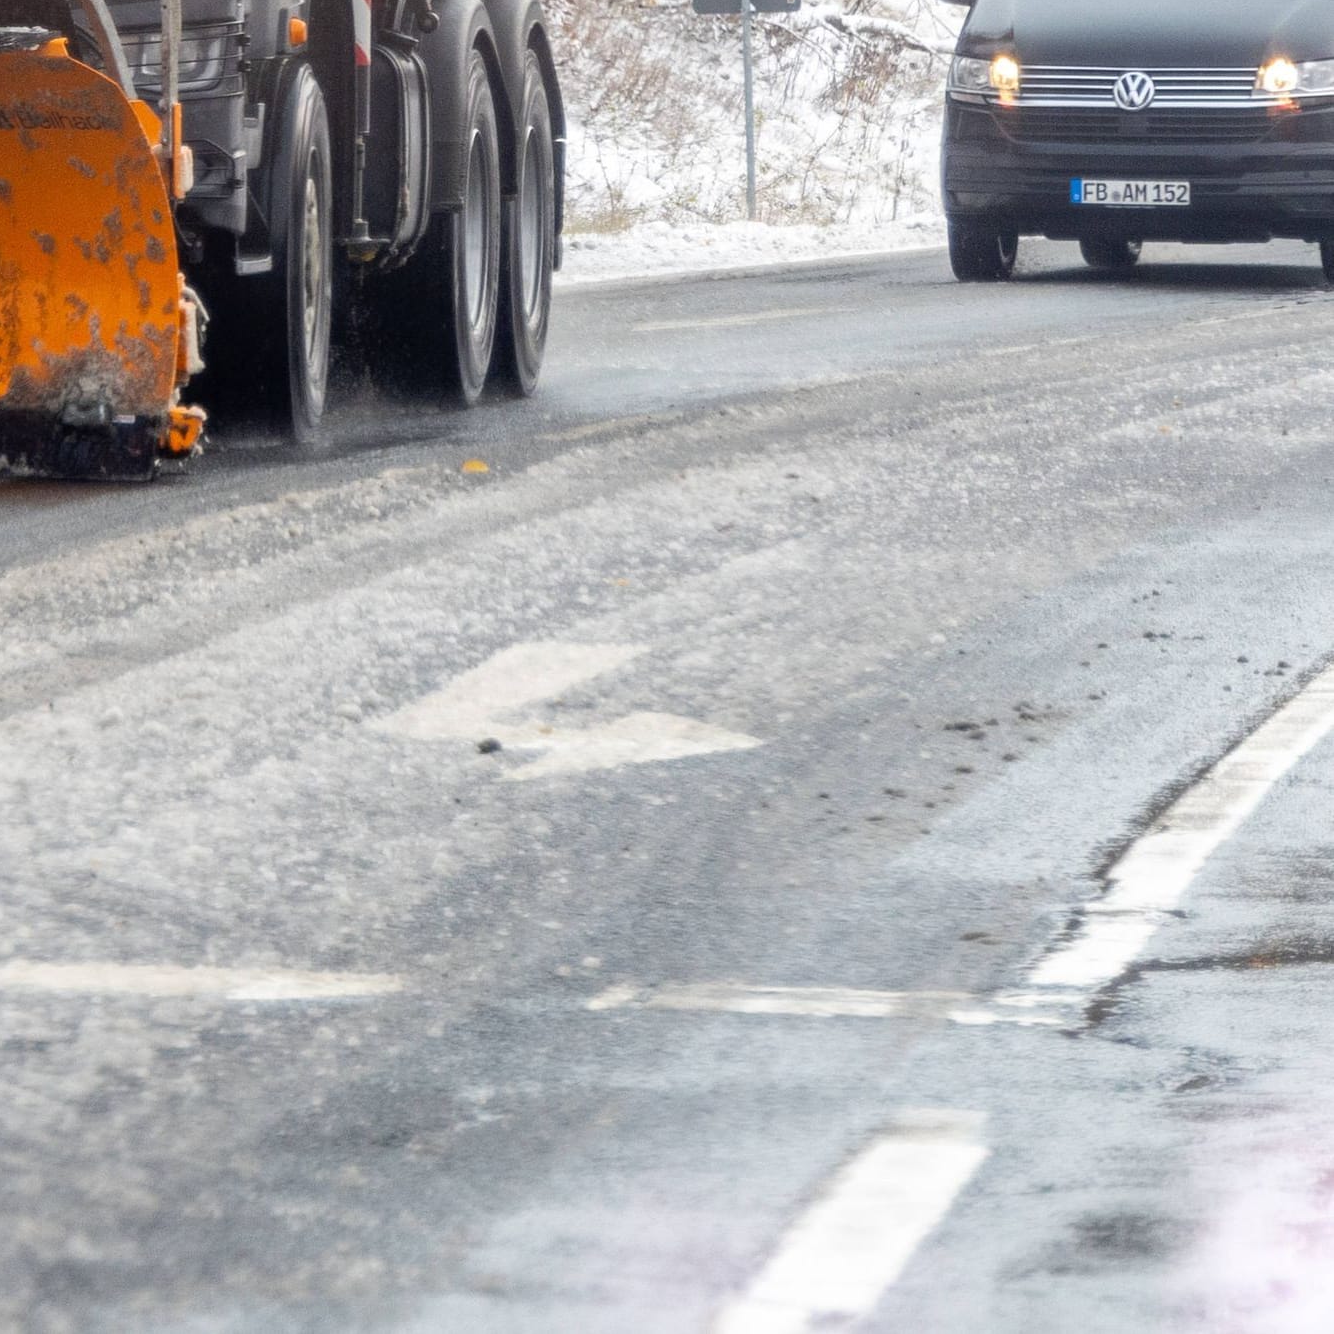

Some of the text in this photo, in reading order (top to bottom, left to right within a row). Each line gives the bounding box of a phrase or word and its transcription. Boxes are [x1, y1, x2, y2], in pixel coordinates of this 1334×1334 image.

[1083, 183, 1188, 203] FB AM 152
